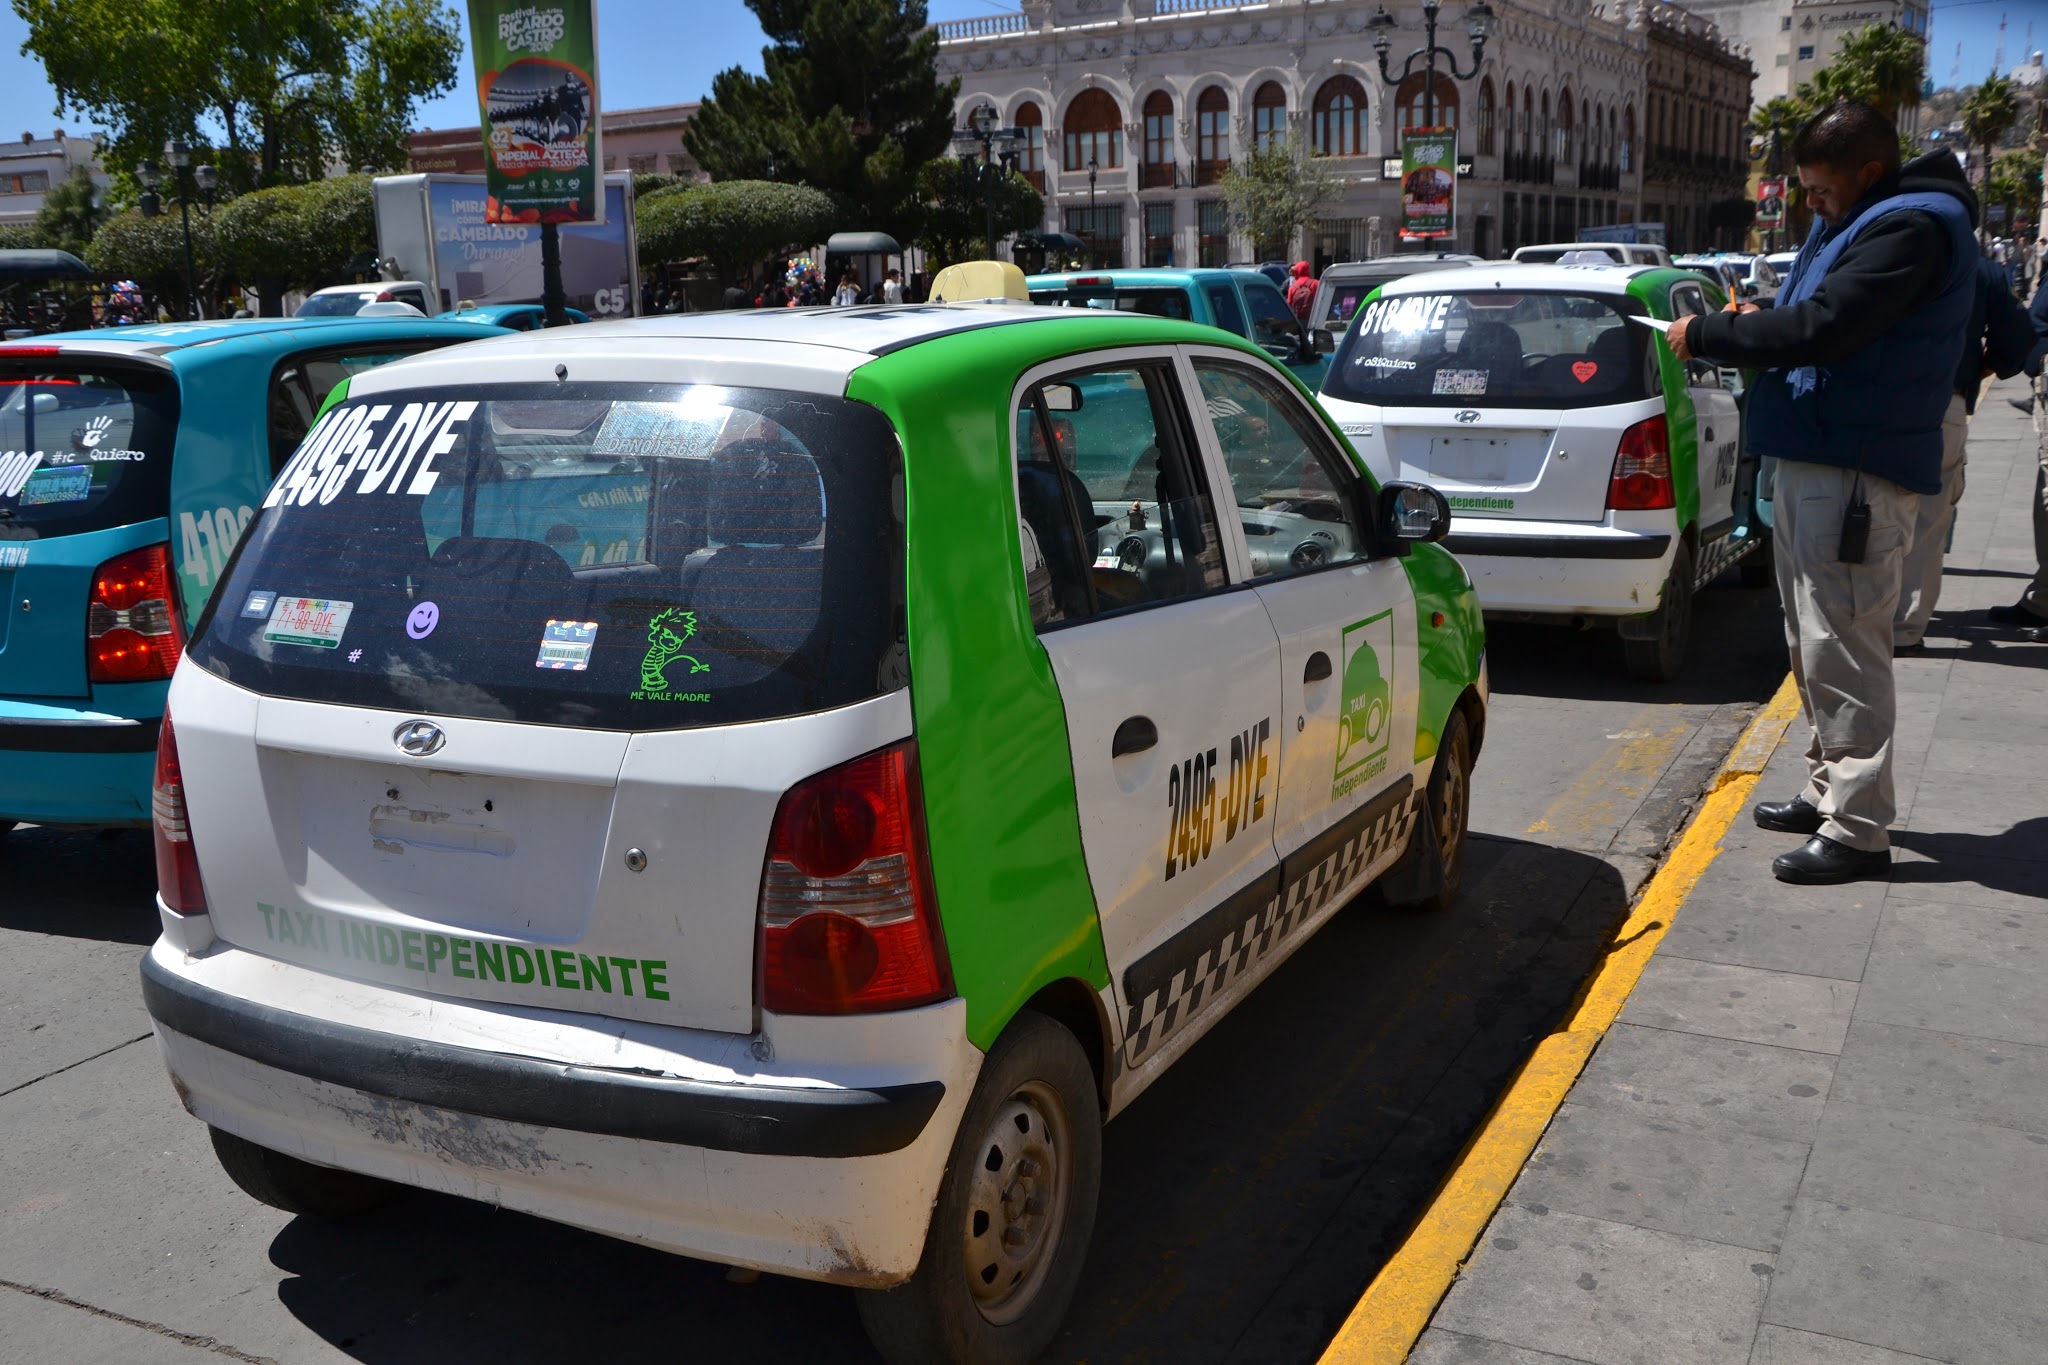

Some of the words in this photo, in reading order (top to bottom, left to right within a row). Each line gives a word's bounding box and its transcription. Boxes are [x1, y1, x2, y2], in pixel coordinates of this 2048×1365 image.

[499, 6, 536, 24] Festival
[499, 14, 564, 39] RICARDO
[507, 27, 564, 51] CASTRO
[490, 130, 509, 141] 02
[544, 140, 586, 149] MARIACHI
[497, 150, 540, 161] IMPERIAL
[542, 149, 588, 160] AZTECA
[415, 158, 457, 170] Scotiabank
[496, 161, 516, 169] Plaza
[550, 159, 572, 168] 20:00
[457, 214, 486, 226] cómo
[437, 226, 529, 242] CAMBIADO
[461, 241, 527, 271] Durango!
[594, 289, 625, 314] C5
[90, 448, 145, 461] Quiero
[262, 401, 479, 508] 2495-DYE
[276, 609, 337, 633] 71-88-DYE
[630, 691, 644, 700] ME
[647, 692, 672, 701] VALE
[674, 692, 711, 702] MADRE
[1350, 694, 1366, 714] TAXI
[1332, 756, 1387, 802] Independiente
[257, 901, 328, 953] TAXI
[339, 919, 670, 1001] INDEPENDIENTE
